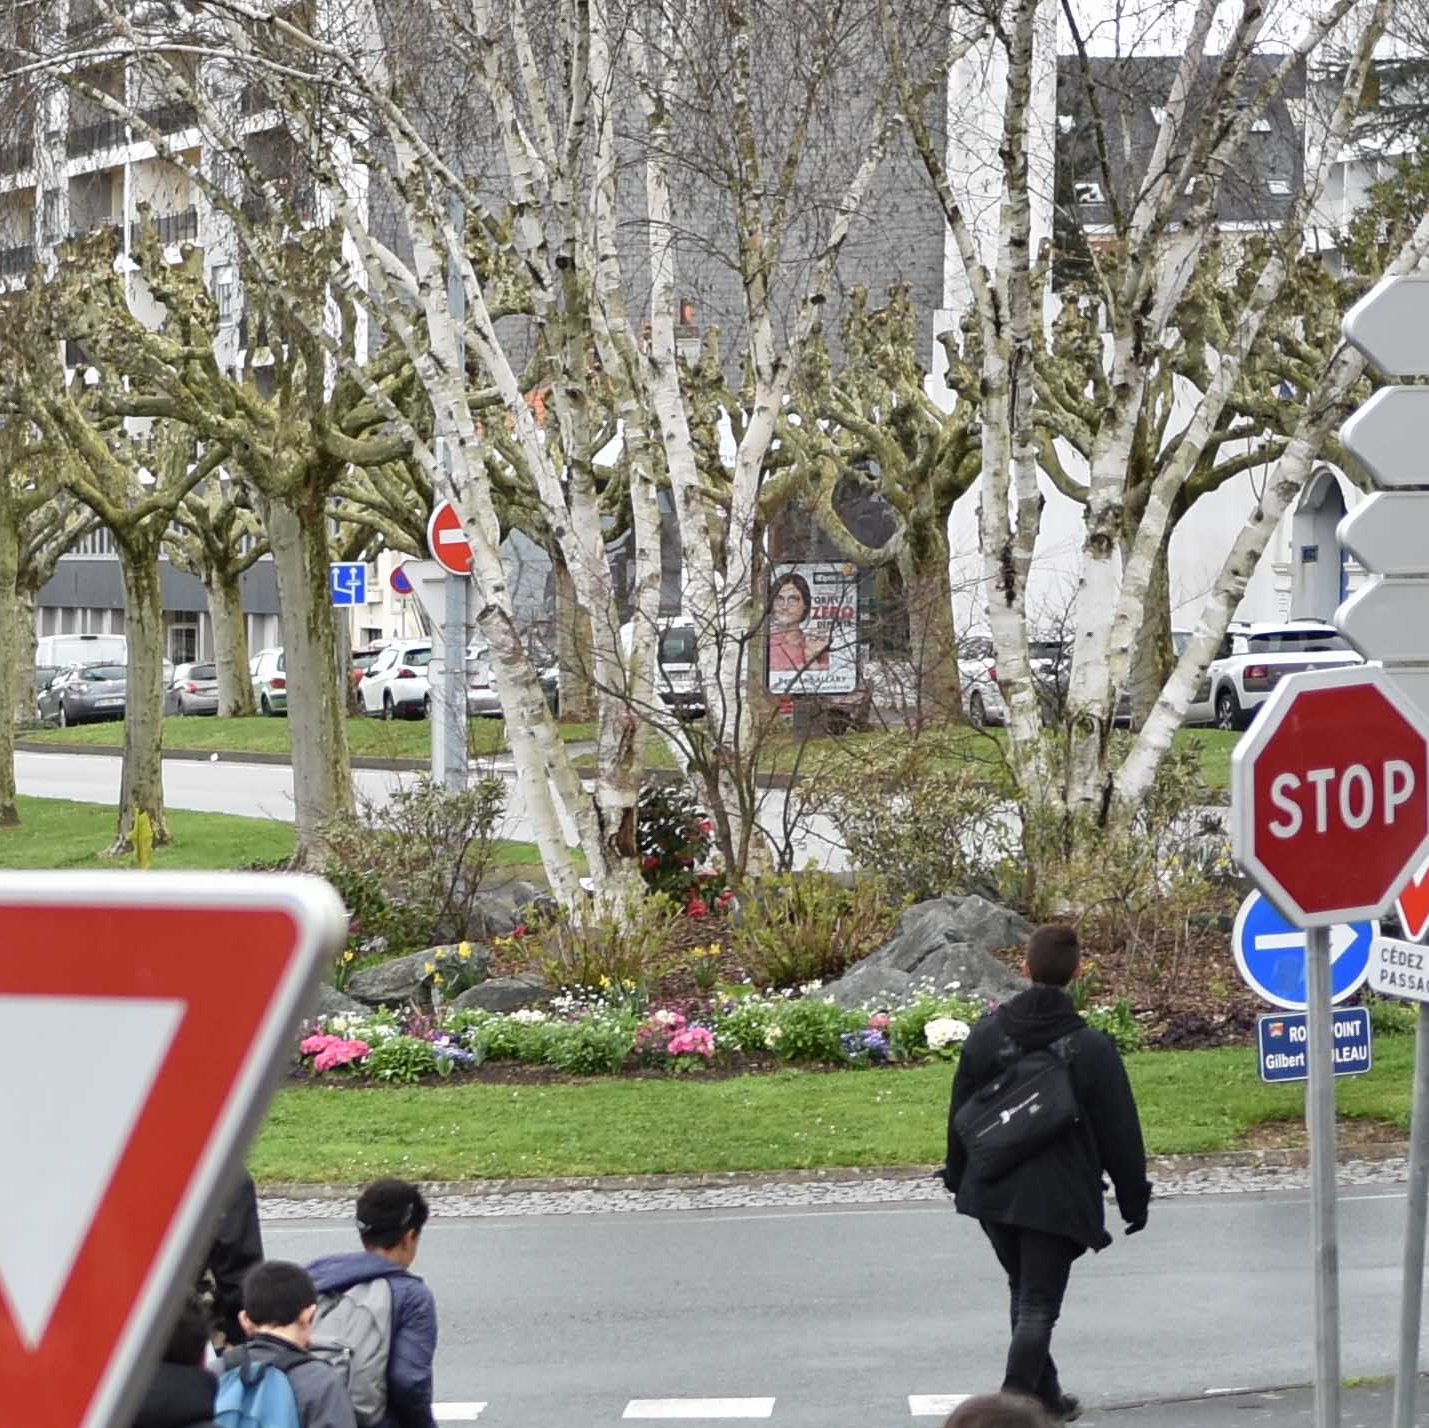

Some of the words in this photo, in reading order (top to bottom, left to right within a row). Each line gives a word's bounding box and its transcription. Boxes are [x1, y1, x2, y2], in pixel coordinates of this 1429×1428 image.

[1268, 760, 1416, 840] STOP
[1381, 946, 1424, 970] CÉDEZ
[1332, 1020, 1361, 1038] OINT
[1265, 1053, 1305, 1070] Gilbert
